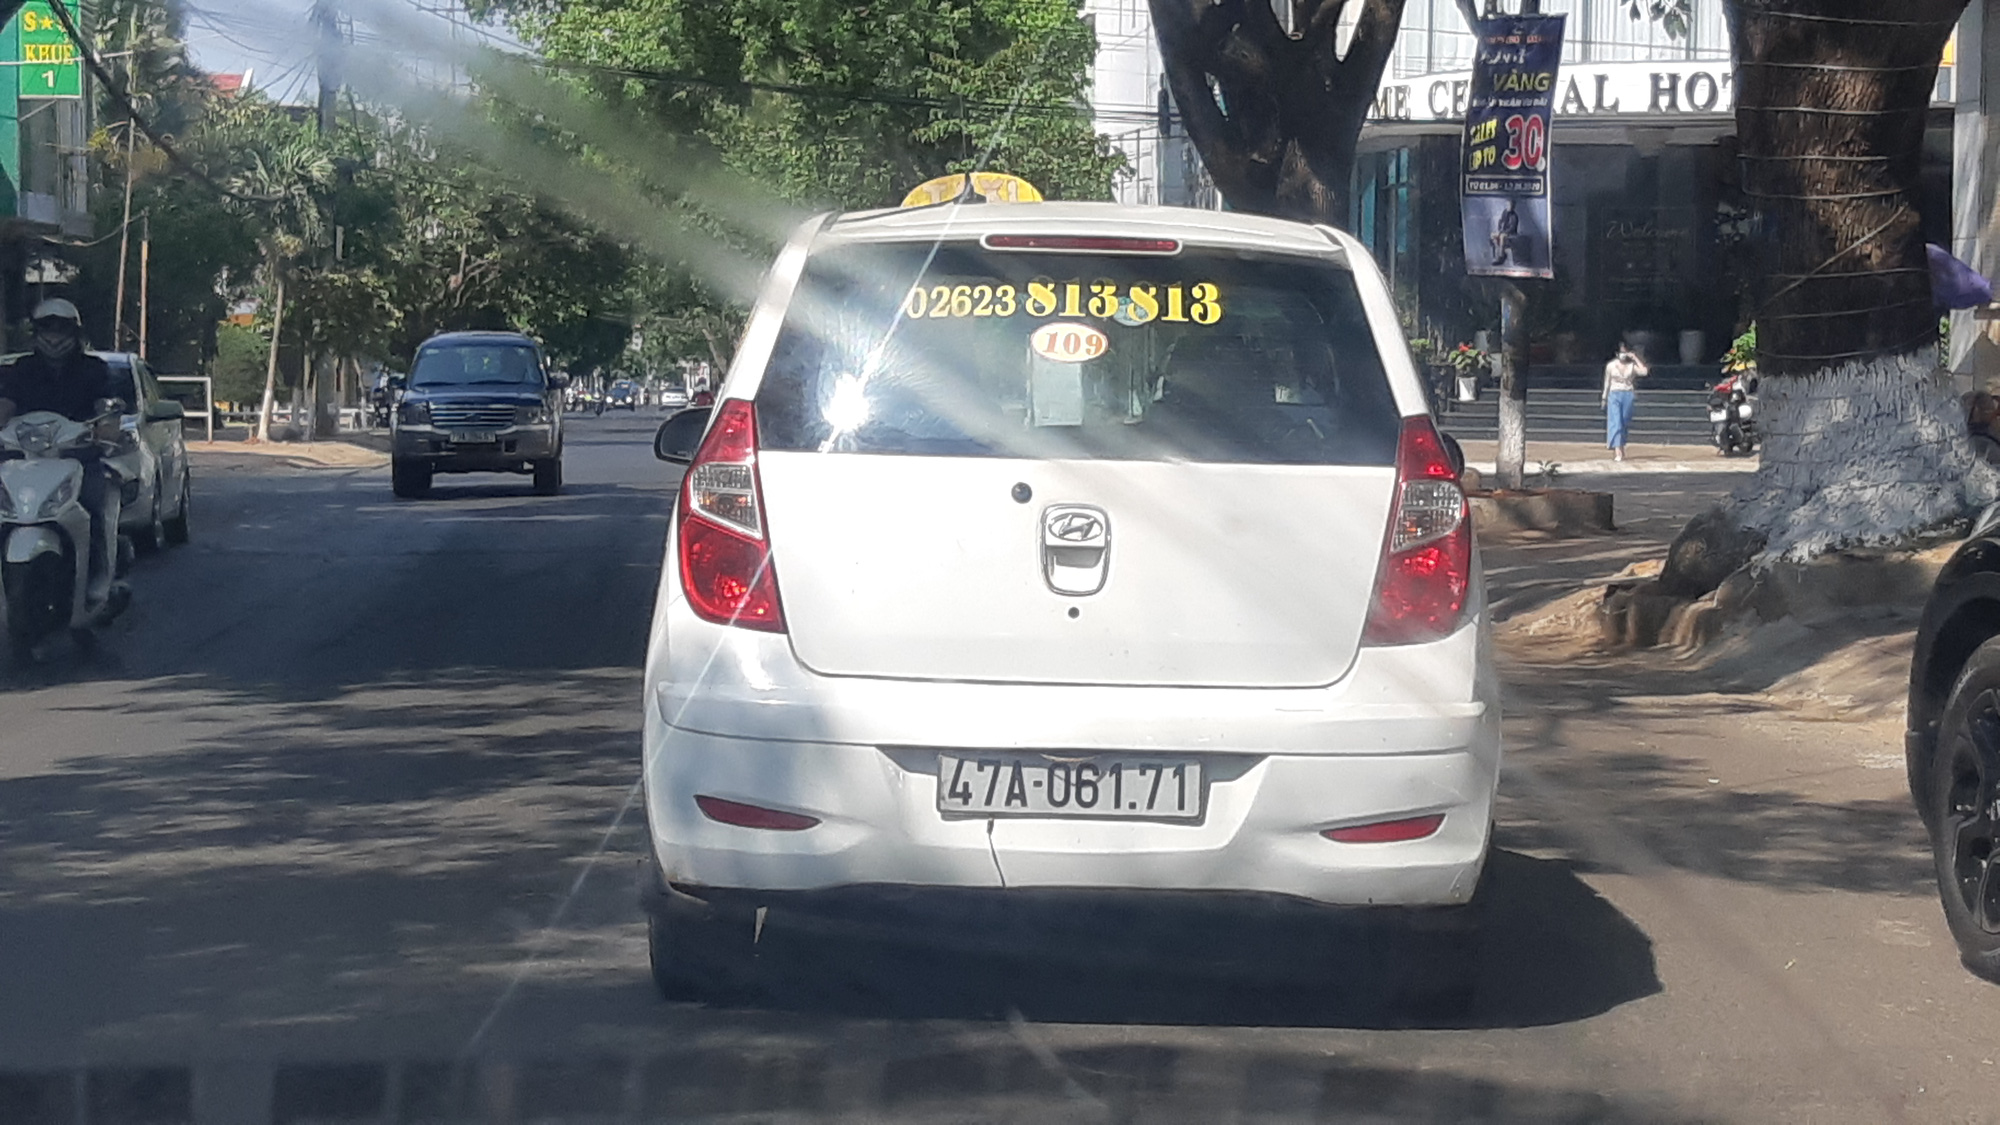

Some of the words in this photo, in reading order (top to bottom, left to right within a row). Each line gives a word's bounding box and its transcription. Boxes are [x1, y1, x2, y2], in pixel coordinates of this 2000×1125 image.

[42, 70, 55, 88] 1
[906, 285, 1016, 318] 02623
[1025, 276, 1119, 317] 813
[1126, 280, 1222, 325] 813
[1041, 331, 1104, 355] 109
[948, 759, 1186, 811] 47A-061.71
